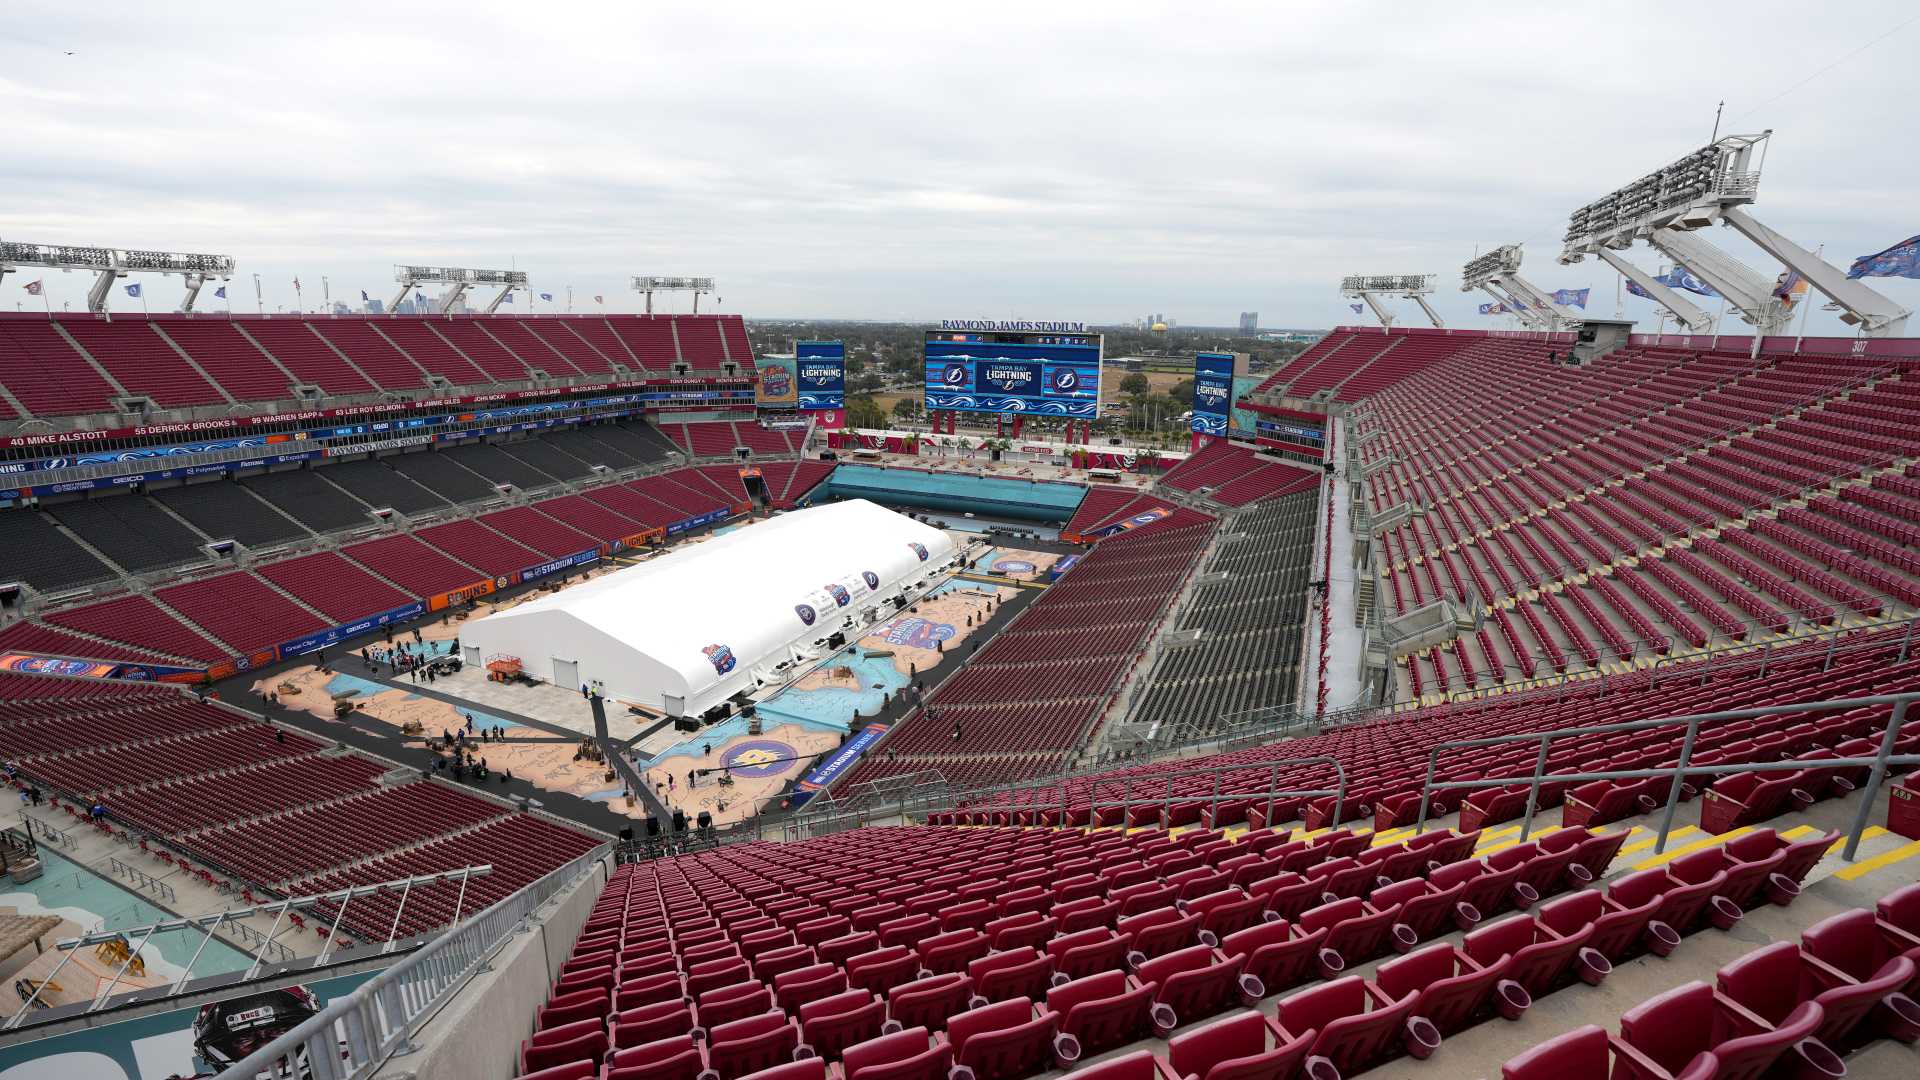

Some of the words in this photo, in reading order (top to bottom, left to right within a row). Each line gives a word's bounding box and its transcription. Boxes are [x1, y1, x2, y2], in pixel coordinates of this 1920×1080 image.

[942, 320, 995, 331] RAYMOND
[996, 320, 1033, 331] JAMES
[1034, 321, 1084, 332] STADIUM
[1851, 340, 1867, 352] 307
[802, 369, 841, 378] LIGHTNING
[986, 370, 1032, 381] LIGHTNING
[1196, 386, 1228, 398] LIGHTNING
[345, 407, 358, 415] LEE
[374, 403, 400, 412] SELMON
[263, 414, 296, 423] WARREN
[298, 411, 318, 420] SAPP
[135, 427, 147, 435] 55
[148, 423, 190, 434] DERRICK
[193, 419, 230, 430] BROOKS
[11, 437, 24, 446] 40
[28, 435, 57, 445] MIKE
[59, 431, 108, 442] ALSTOTT
[113, 475, 144, 484] GEICO
[541, 557, 573, 575] STADIUM
[573, 550, 596, 564] SERIES
[346, 621, 371, 633] GEICO
